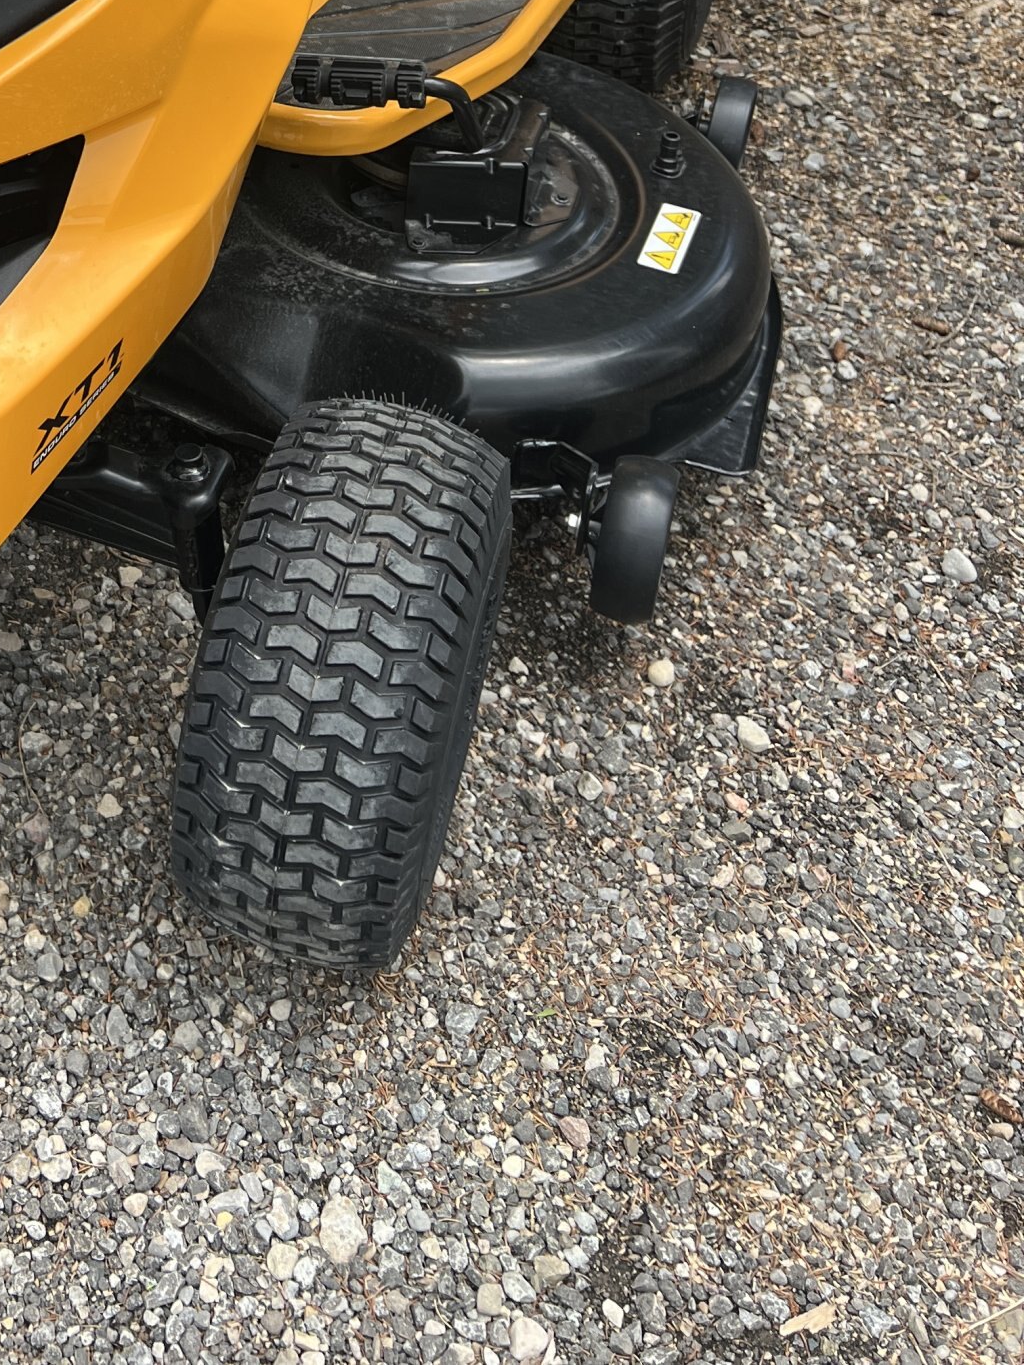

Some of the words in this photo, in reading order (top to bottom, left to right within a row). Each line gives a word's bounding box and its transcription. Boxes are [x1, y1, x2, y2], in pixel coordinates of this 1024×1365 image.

[33, 338, 125, 458] XT1
[33, 415, 77, 470] ENDURO
[79, 371, 115, 416] SERIES
